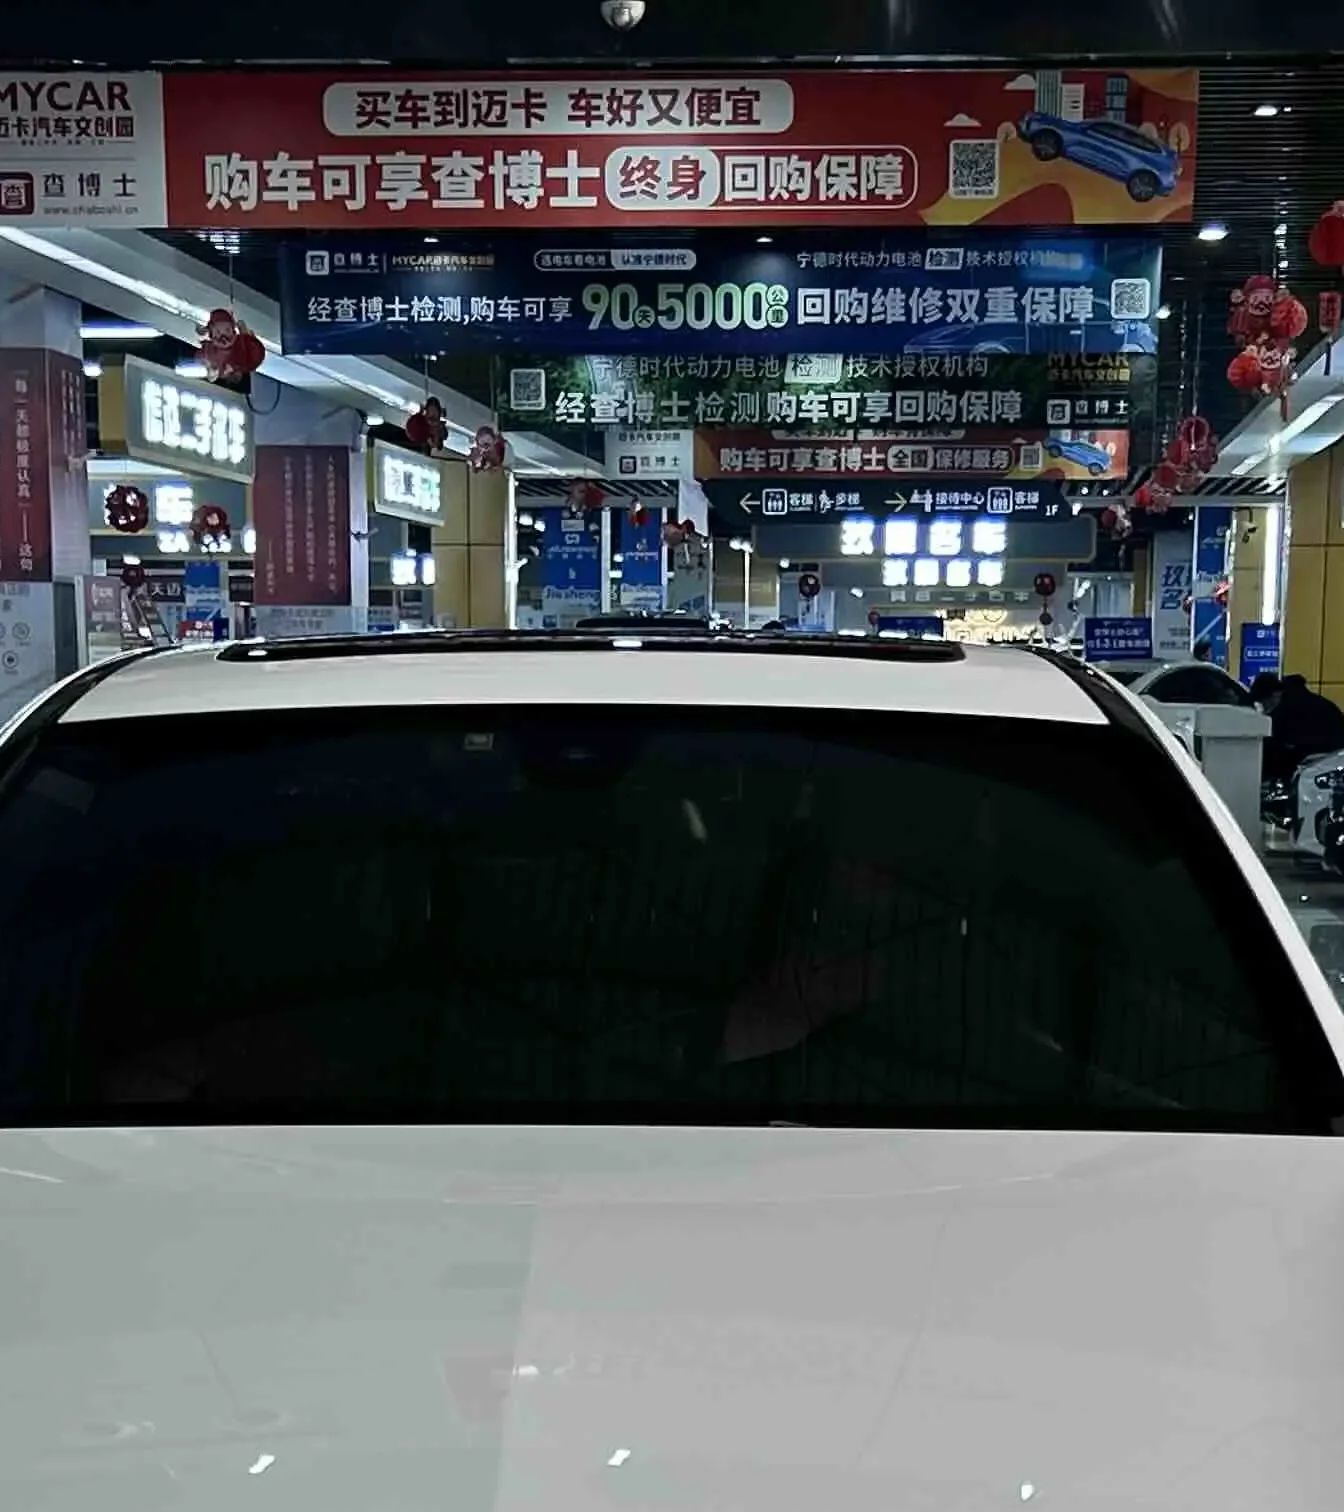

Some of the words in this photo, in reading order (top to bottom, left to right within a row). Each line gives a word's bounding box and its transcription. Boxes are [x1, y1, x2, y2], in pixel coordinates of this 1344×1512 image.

[356, 88, 547, 128] 买车到迈卡
[567, 86, 761, 128] 车好又便宜
[42, 173, 136, 197] 查博士
[798, 286, 1094, 324] 回购维修双重保障
